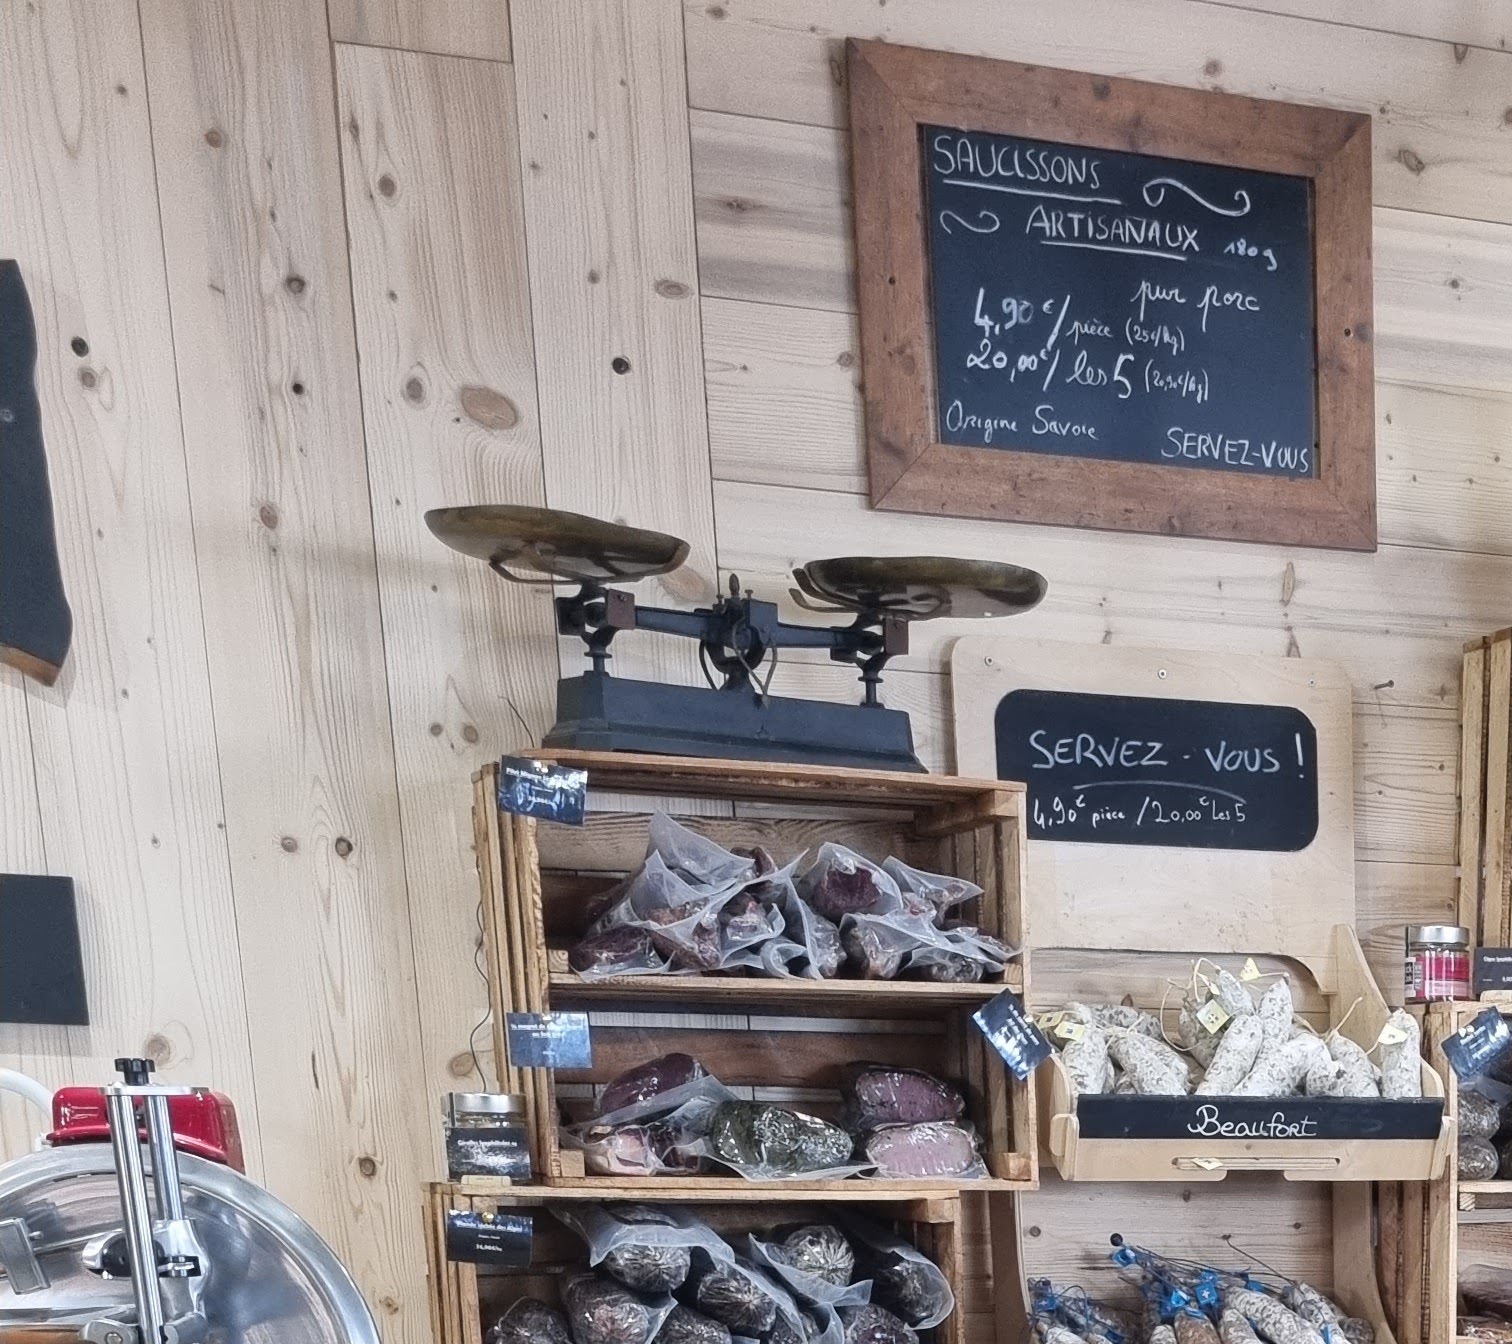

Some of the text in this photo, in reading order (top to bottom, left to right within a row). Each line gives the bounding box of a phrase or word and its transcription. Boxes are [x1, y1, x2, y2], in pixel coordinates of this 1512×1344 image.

[933, 134, 1101, 189] SAUCISSONS
[1026, 205, 1200, 252] ARTISANAUX
[1130, 279, 1261, 333] pur porc
[945, 399, 1100, 443] Origine Savoie
[1029, 729, 1169, 769] SERVEZ
[1204, 740, 1281, 773] VOUS
[1187, 1104, 1318, 1138] Beaufort
